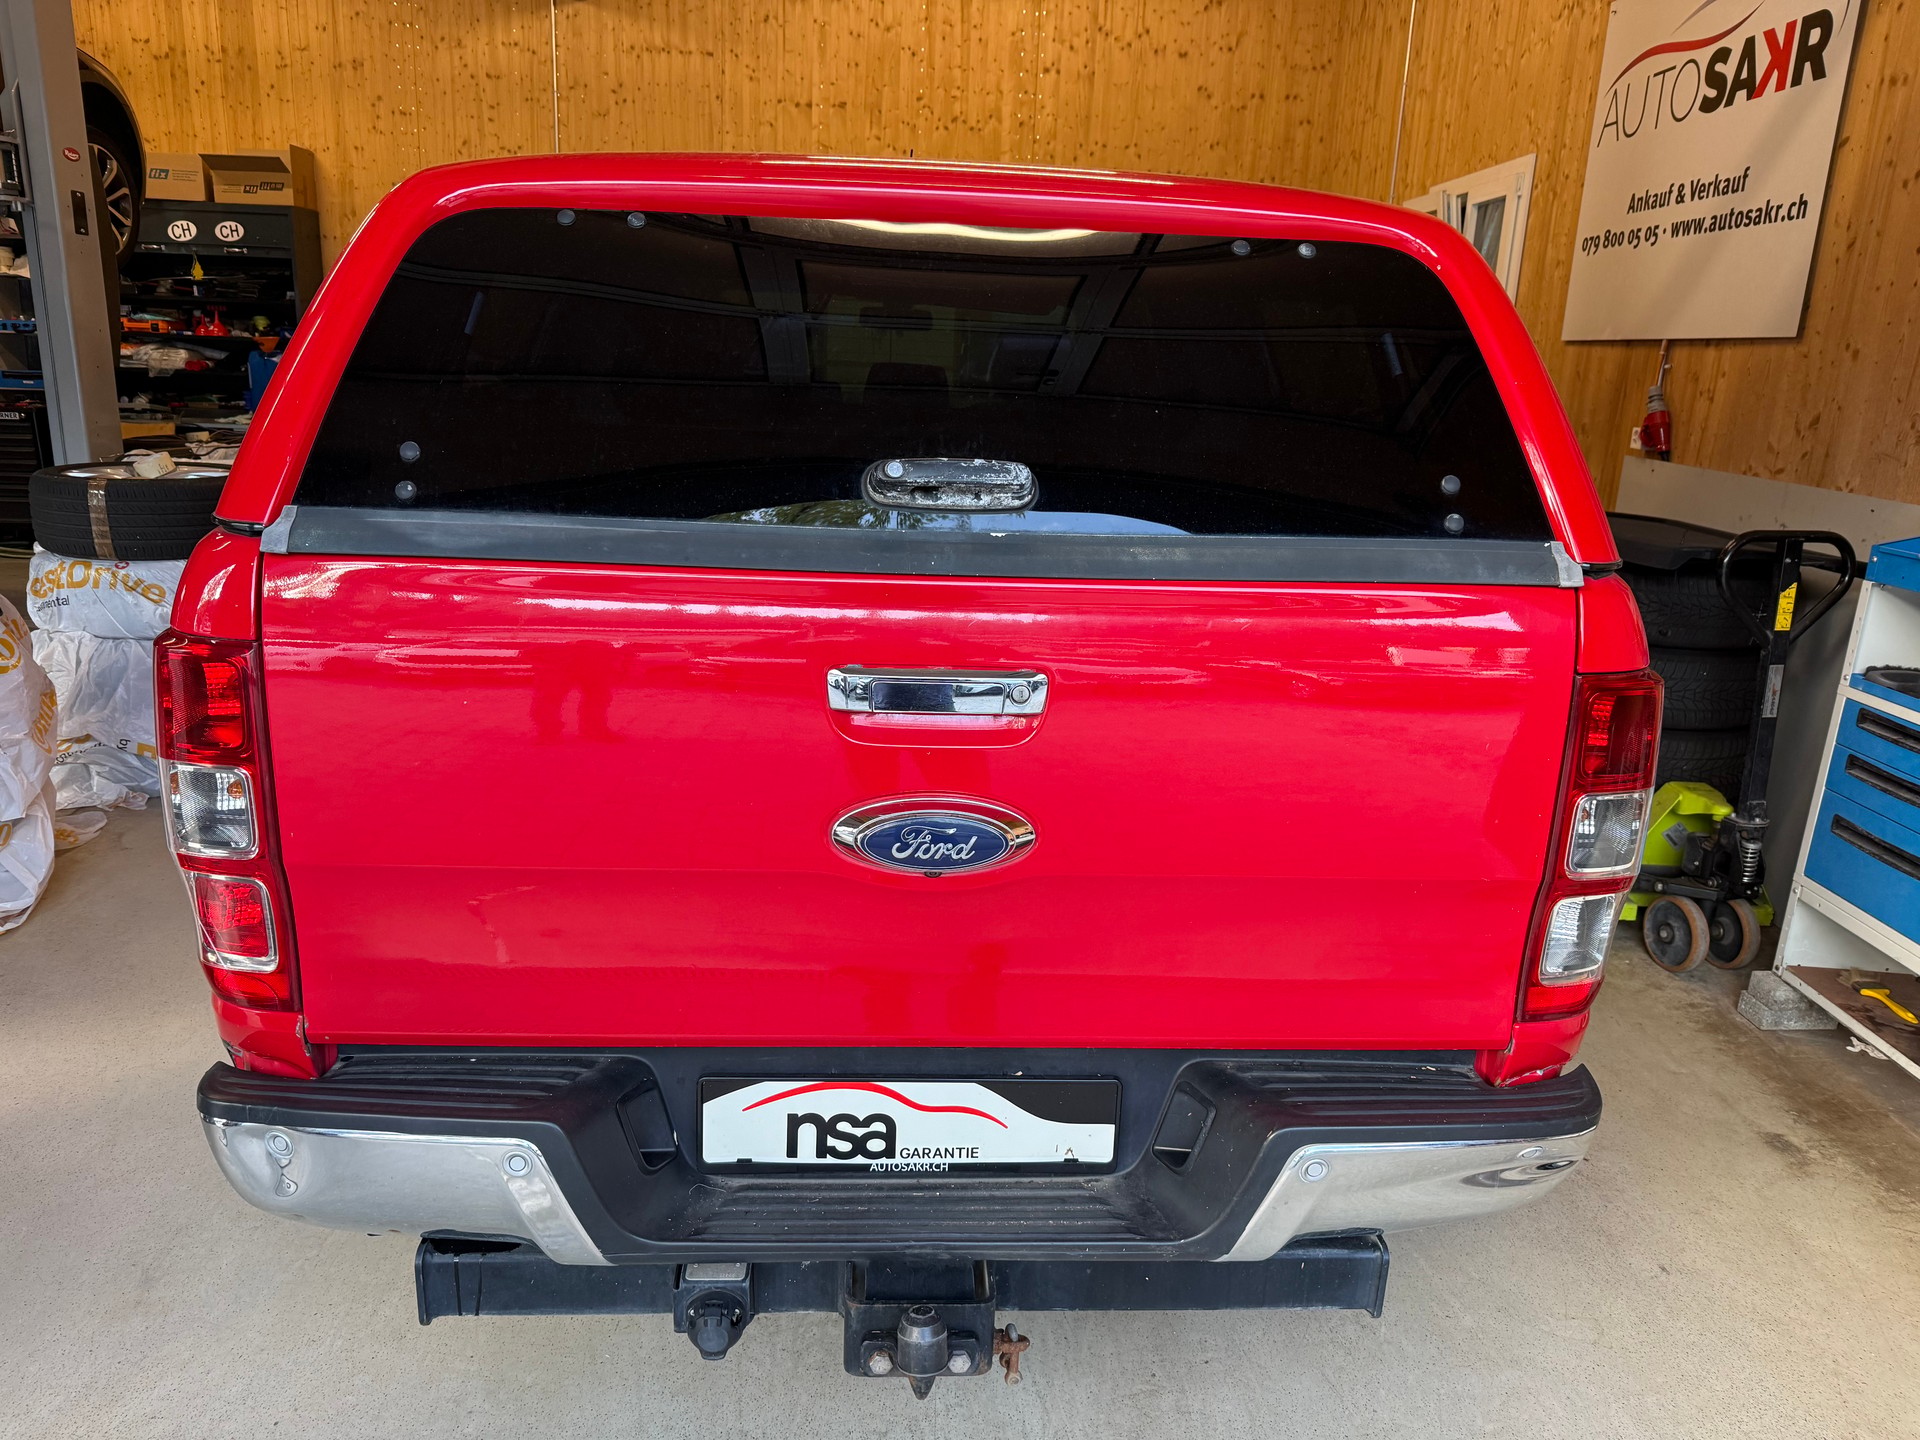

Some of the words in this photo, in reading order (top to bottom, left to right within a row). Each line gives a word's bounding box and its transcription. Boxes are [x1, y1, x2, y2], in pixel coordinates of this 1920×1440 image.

[1597, 8, 1834, 148] AUTOSAKR
[150, 168, 166, 179] fix
[1627, 183, 1675, 215] Ankauf
[1675, 183, 1686, 205] &
[1690, 166, 1751, 202] Verkauf
[171, 222, 193, 239] CH
[220, 224, 240, 239] CH
[1581, 235, 1600, 256] 079
[1603, 229, 1624, 248] 800
[1627, 227, 1641, 249] 05
[1644, 225, 1660, 246] 05
[1671, 193, 1809, 239] www.autosakr.ch
[891, 825, 978, 859] Ford
[786, 1112, 897, 1160] nsa
[900, 1147, 979, 1159] GARANTIE
[869, 1163, 949, 1172] AUTOSAKR.CH
